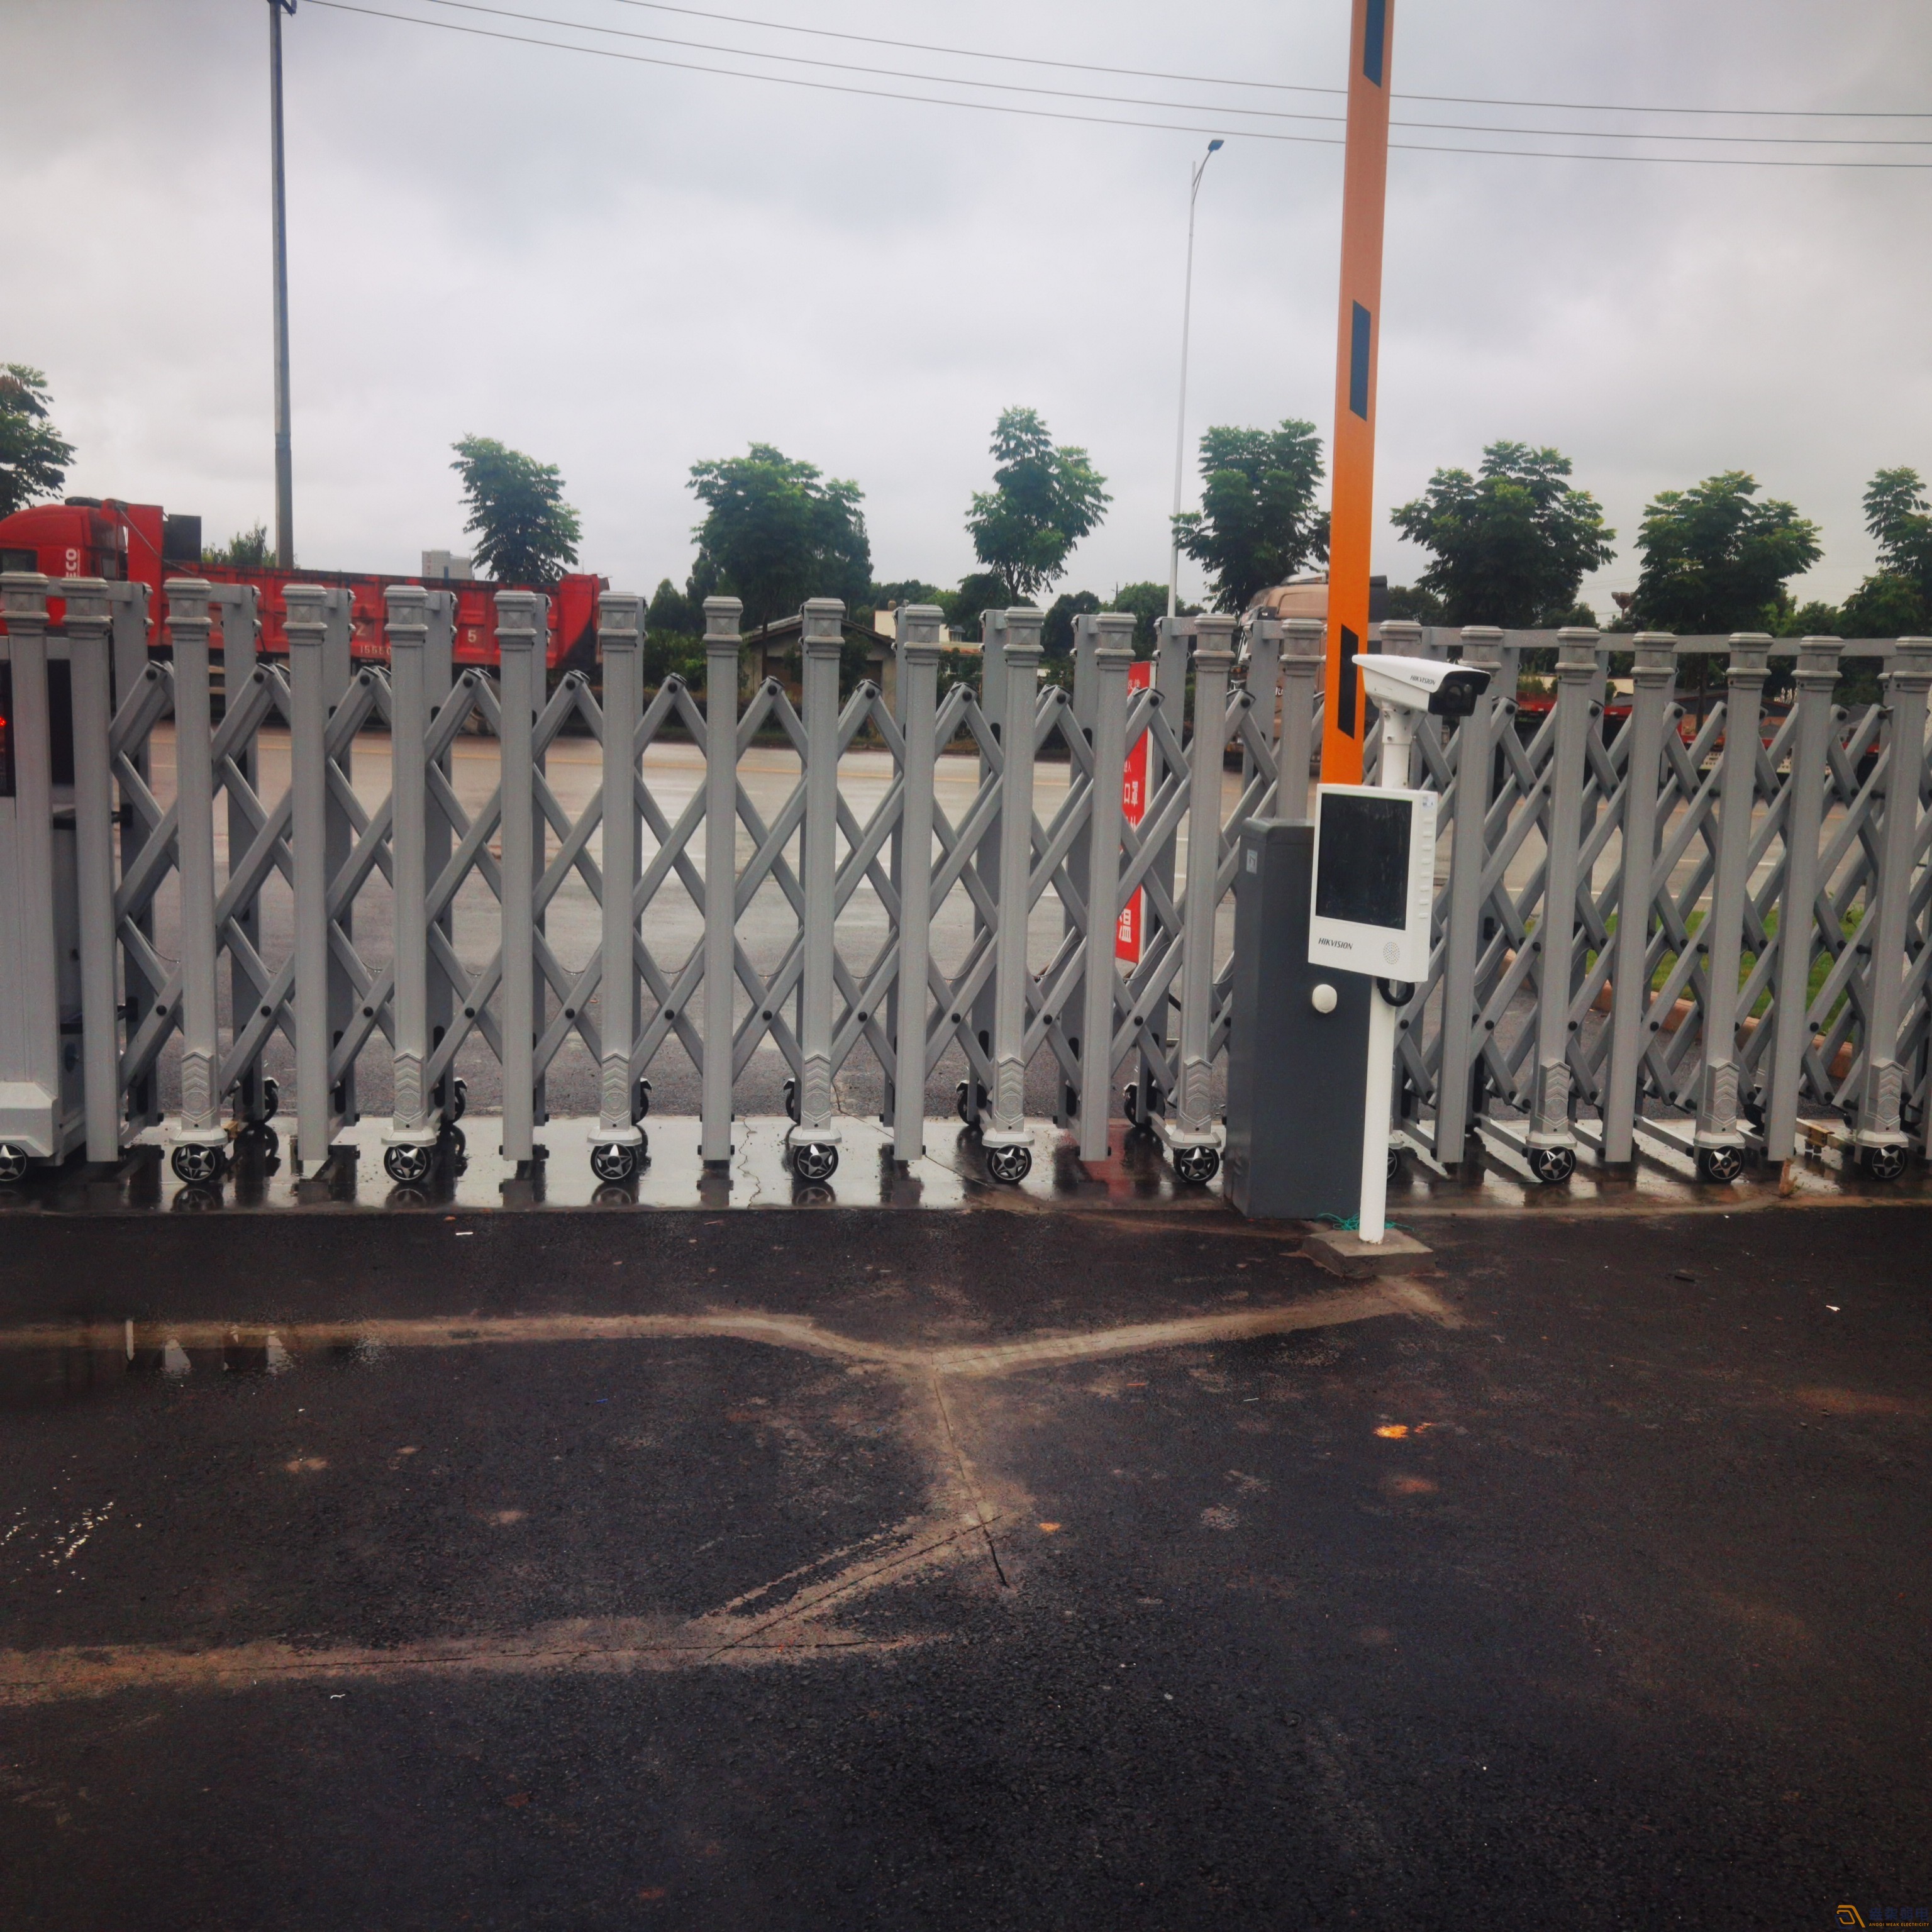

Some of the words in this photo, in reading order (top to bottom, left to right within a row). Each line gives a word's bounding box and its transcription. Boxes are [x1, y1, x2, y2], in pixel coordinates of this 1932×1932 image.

[65, 548, 77, 578] ECO
[468, 629, 477, 643] 5
[1410, 675, 1436, 686] HIKVISION
[1124, 780, 1138, 808] 口罩
[1318, 937, 1353, 950] HIKVISION
